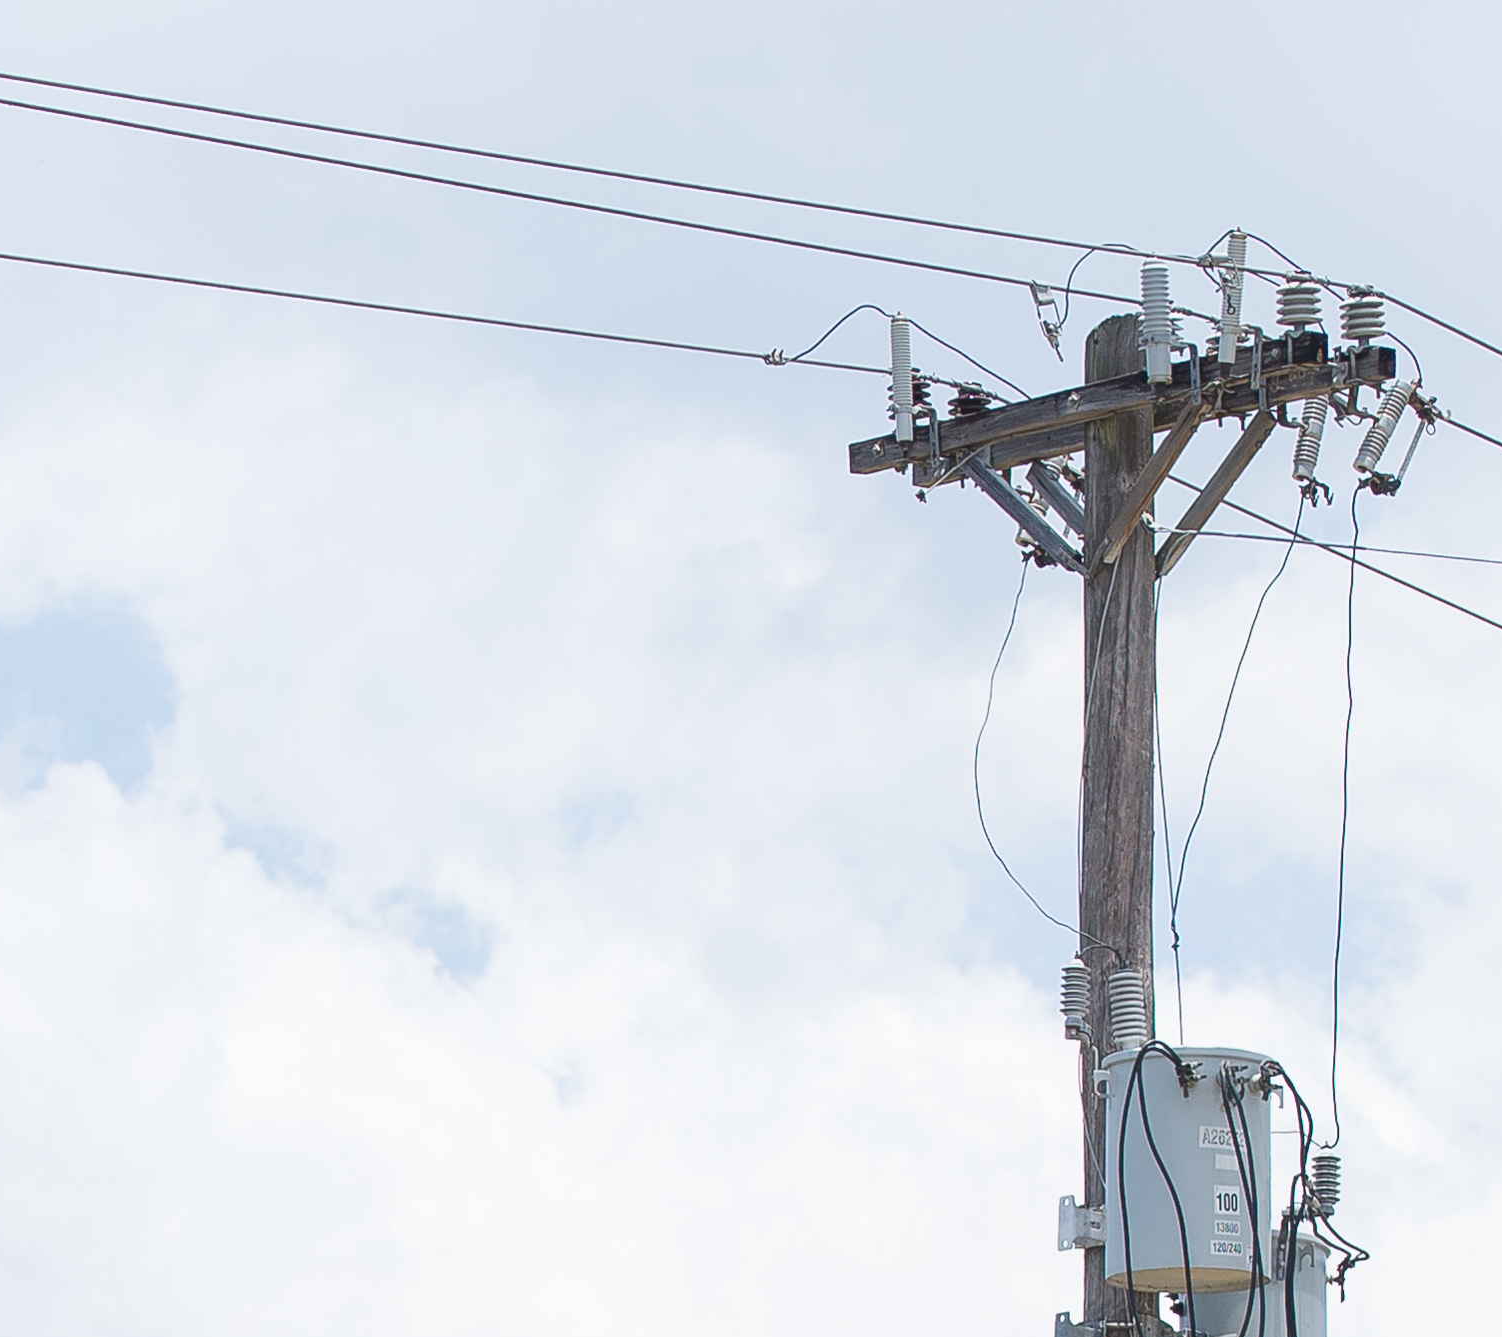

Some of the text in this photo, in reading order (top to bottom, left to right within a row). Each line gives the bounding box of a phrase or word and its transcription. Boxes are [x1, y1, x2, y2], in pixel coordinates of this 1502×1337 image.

[1216, 1193, 1238, 1212] 100
[1216, 1222, 1238, 1234] 13800
[1213, 1242, 1242, 1254] 120/240
